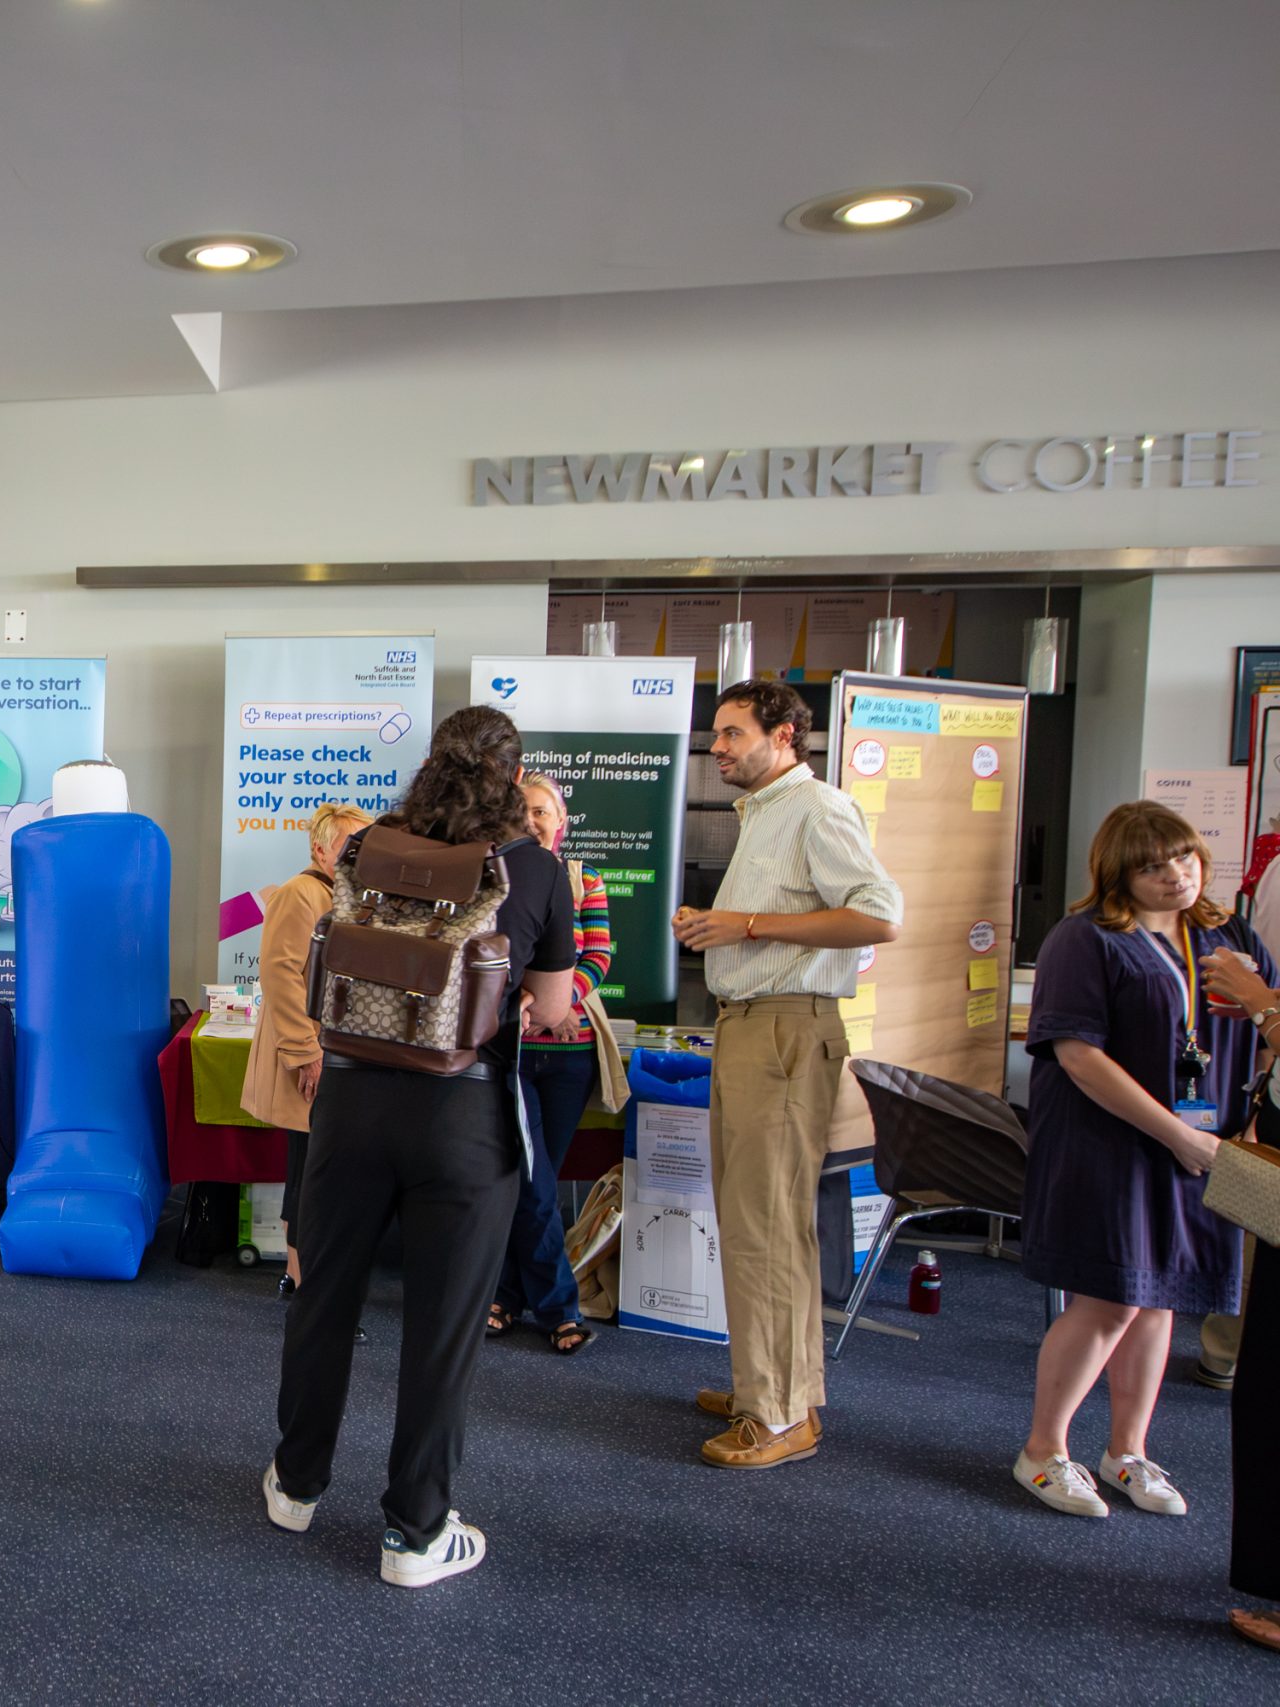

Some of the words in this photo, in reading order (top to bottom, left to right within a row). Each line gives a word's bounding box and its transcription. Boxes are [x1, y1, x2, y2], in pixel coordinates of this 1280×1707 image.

[471, 441, 952, 506] NEWMARKET
[976, 430, 1263, 493] COFFEE
[387, 651, 416, 663] NHS
[373, 665, 400, 673] Suffolk
[402, 665, 416, 673] and
[16, 677, 34, 691] to
[39, 677, 82, 691] start
[633, 679, 673, 695] NHS
[264, 711, 302, 722] Repeat
[305, 711, 382, 723] prescriptions?
[239, 744, 304, 761] Please
[311, 745, 371, 762] check
[521, 751, 571, 766] cribing
[575, 751, 592, 764] of
[594, 752, 670, 766] medicines
[238, 771, 287, 788] your
[293, 769, 348, 786] stock
[356, 770, 397, 786] and
[544, 767, 588, 780] minor
[592, 767, 659, 781] illnesses
[238, 792, 283, 812] only
[237, 818, 275, 834] you
[571, 830, 608, 838] available
[621, 831, 636, 840] buy
[638, 831, 652, 839] will
[575, 841, 620, 850] prescribed
[622, 841, 633, 849] for
[635, 842, 650, 850] the
[564, 851, 609, 860] conditions.
[603, 870, 623, 879] and
[625, 871, 652, 880] fever
[609, 886, 631, 894] skin
[234, 952, 244, 964] If
[597, 987, 623, 995] worm
[663, 1208, 691, 1218] CARRY
[851, 1205, 872, 1214] HARMA
[707, 1236, 717, 1263] TREAT
